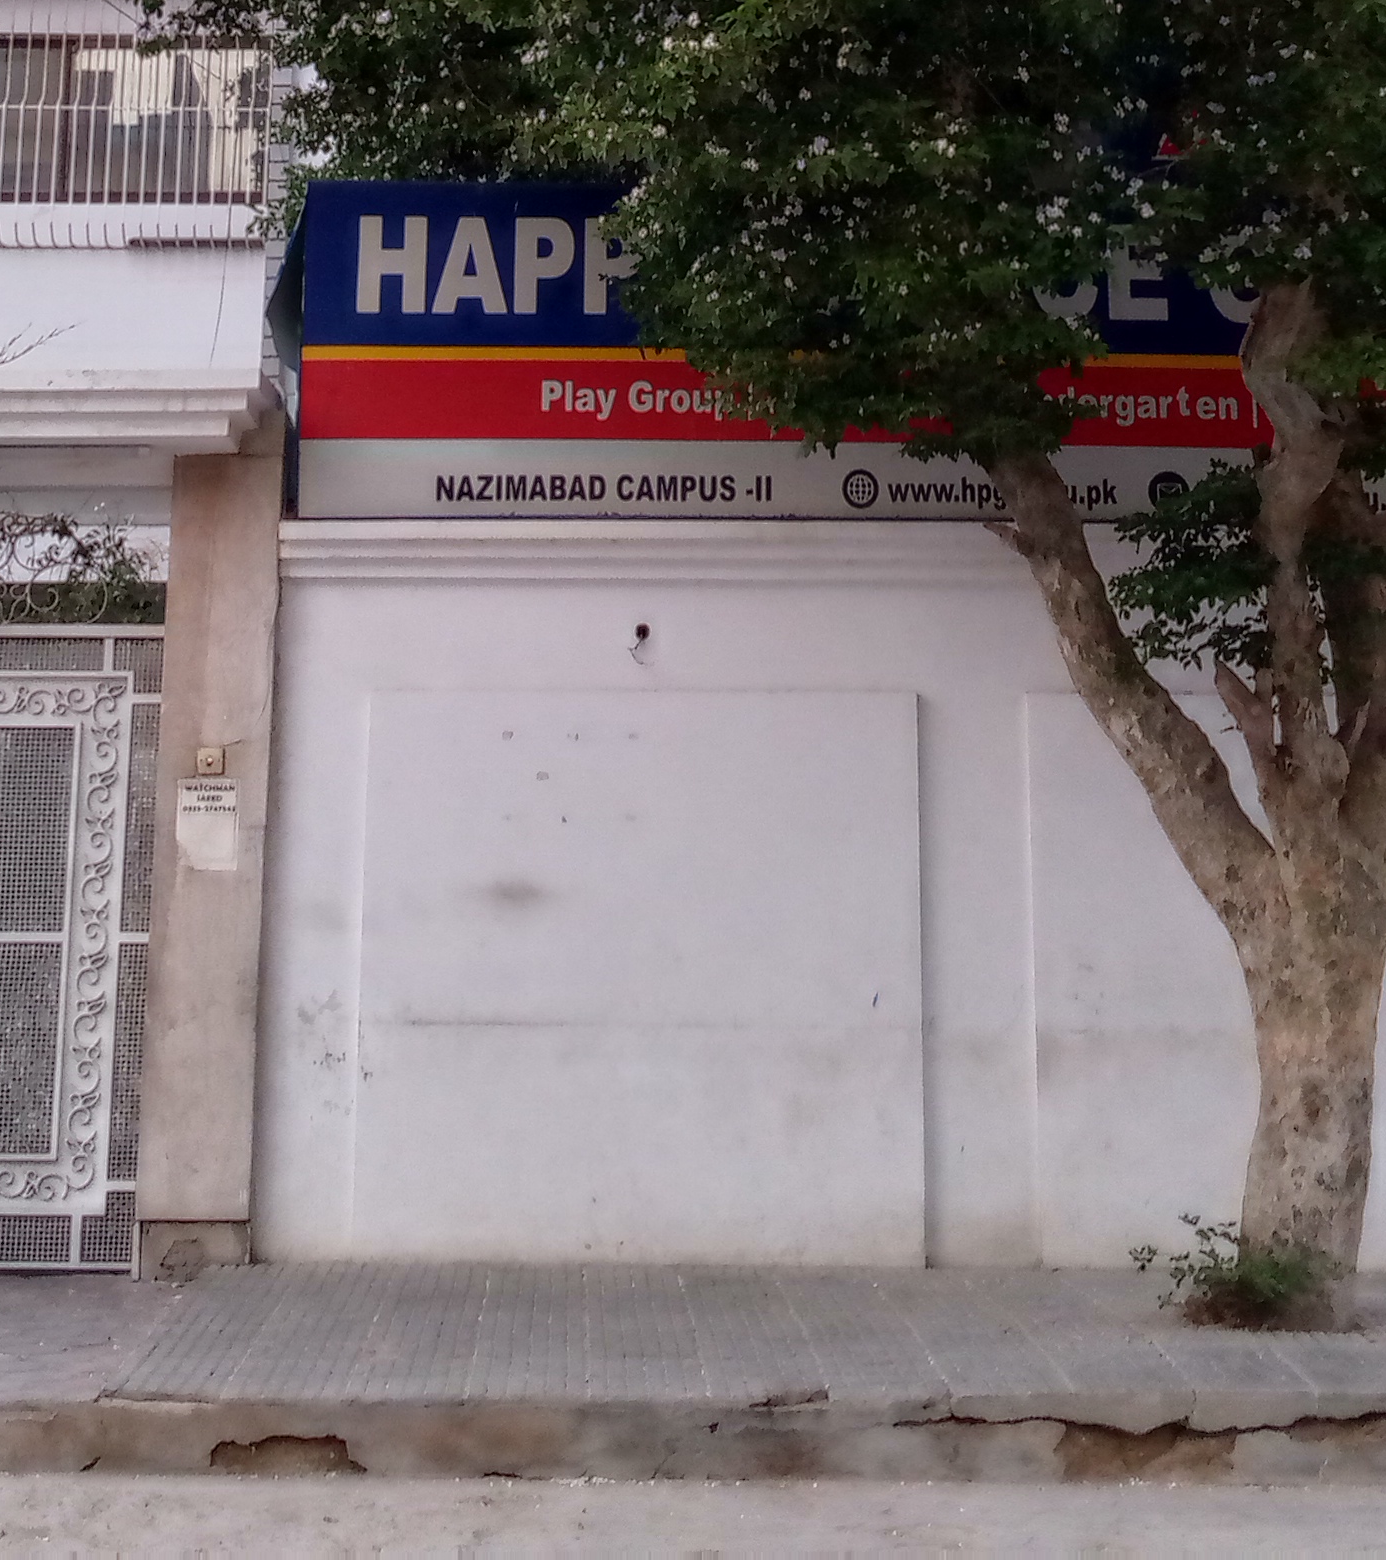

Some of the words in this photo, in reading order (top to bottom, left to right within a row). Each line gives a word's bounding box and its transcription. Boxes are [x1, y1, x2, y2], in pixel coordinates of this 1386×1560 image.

[355, 214, 641, 315] HAPP
[540, 380, 616, 421] Play
[435, 474, 607, 503] NAZIMABAD
[616, 474, 737, 503] CAMPUS
[745, 474, 773, 503] -II
[887, 476, 1118, 512] www.hpgu.pk
[185, 783, 236, 792] WATCHMAN
